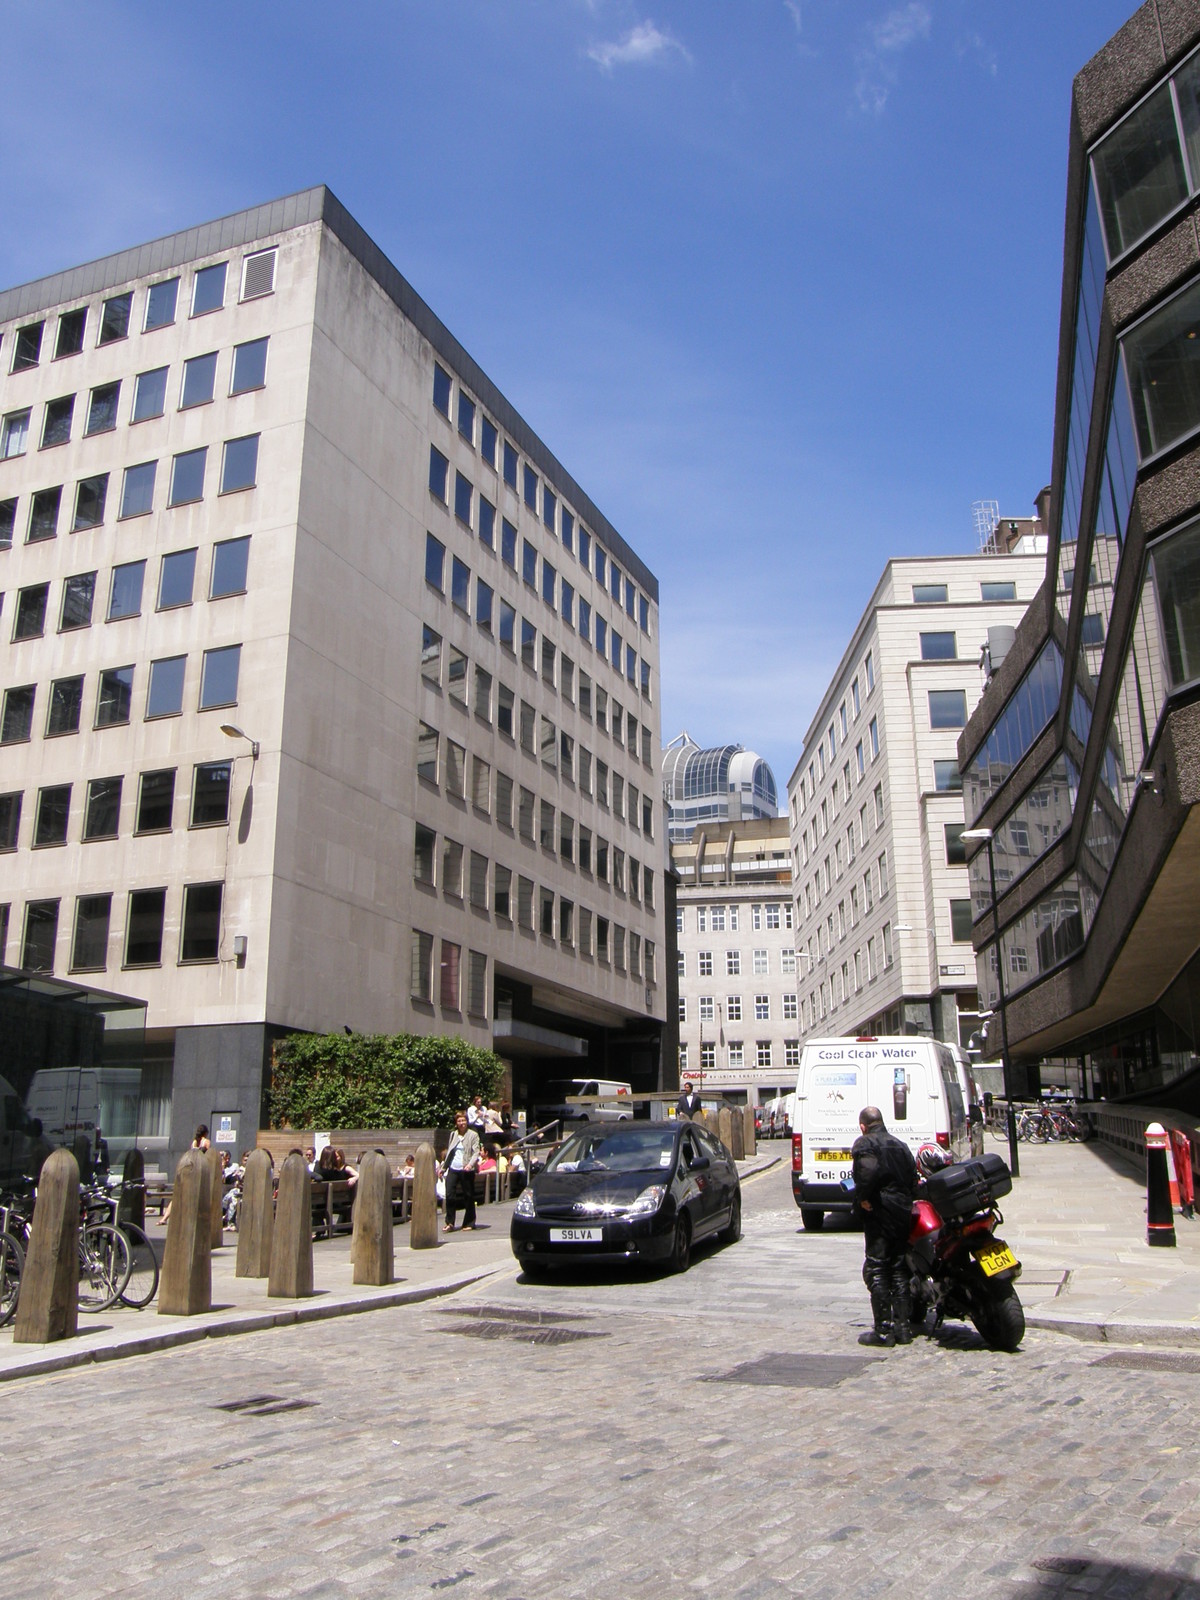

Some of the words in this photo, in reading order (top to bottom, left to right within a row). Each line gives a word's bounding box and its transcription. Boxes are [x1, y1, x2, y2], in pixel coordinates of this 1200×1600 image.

[818, 1050, 844, 1060] Cool
[847, 1049, 878, 1059] Clear
[881, 1048, 917, 1058] Water
[814, 1170, 836, 1180] Tel:
[986, 1253, 1012, 1271] LGN
